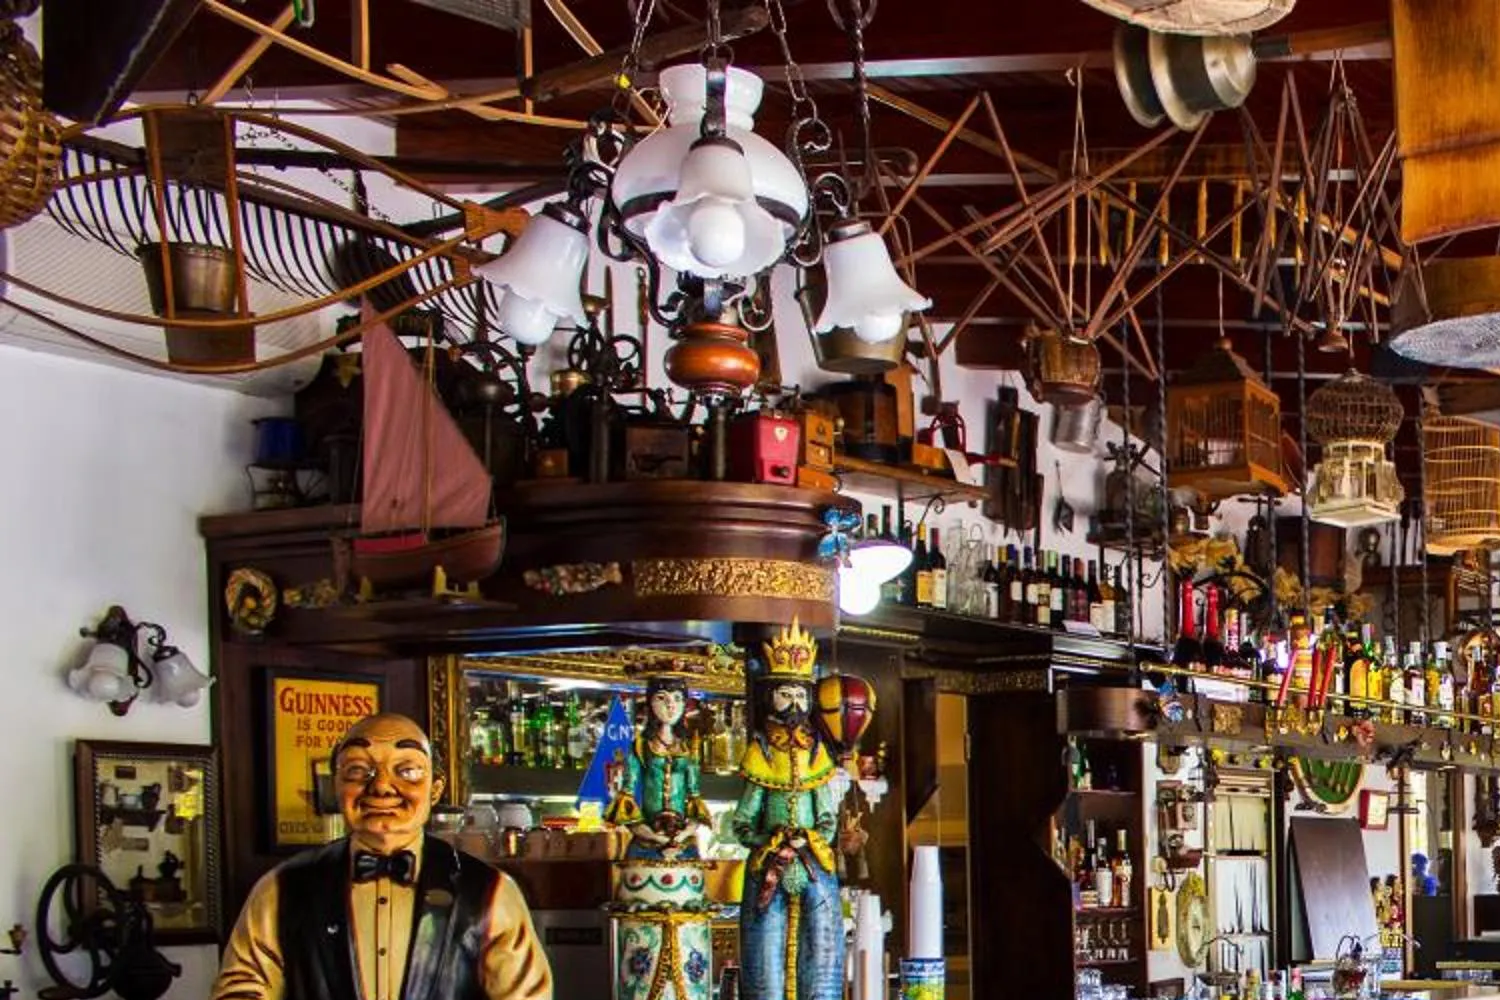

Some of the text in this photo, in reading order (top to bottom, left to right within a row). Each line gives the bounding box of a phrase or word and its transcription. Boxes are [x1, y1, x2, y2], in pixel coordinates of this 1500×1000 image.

[280, 686, 373, 717] GUINNESS
[297, 718, 311, 731] IS
[296, 735, 321, 748] FOR
